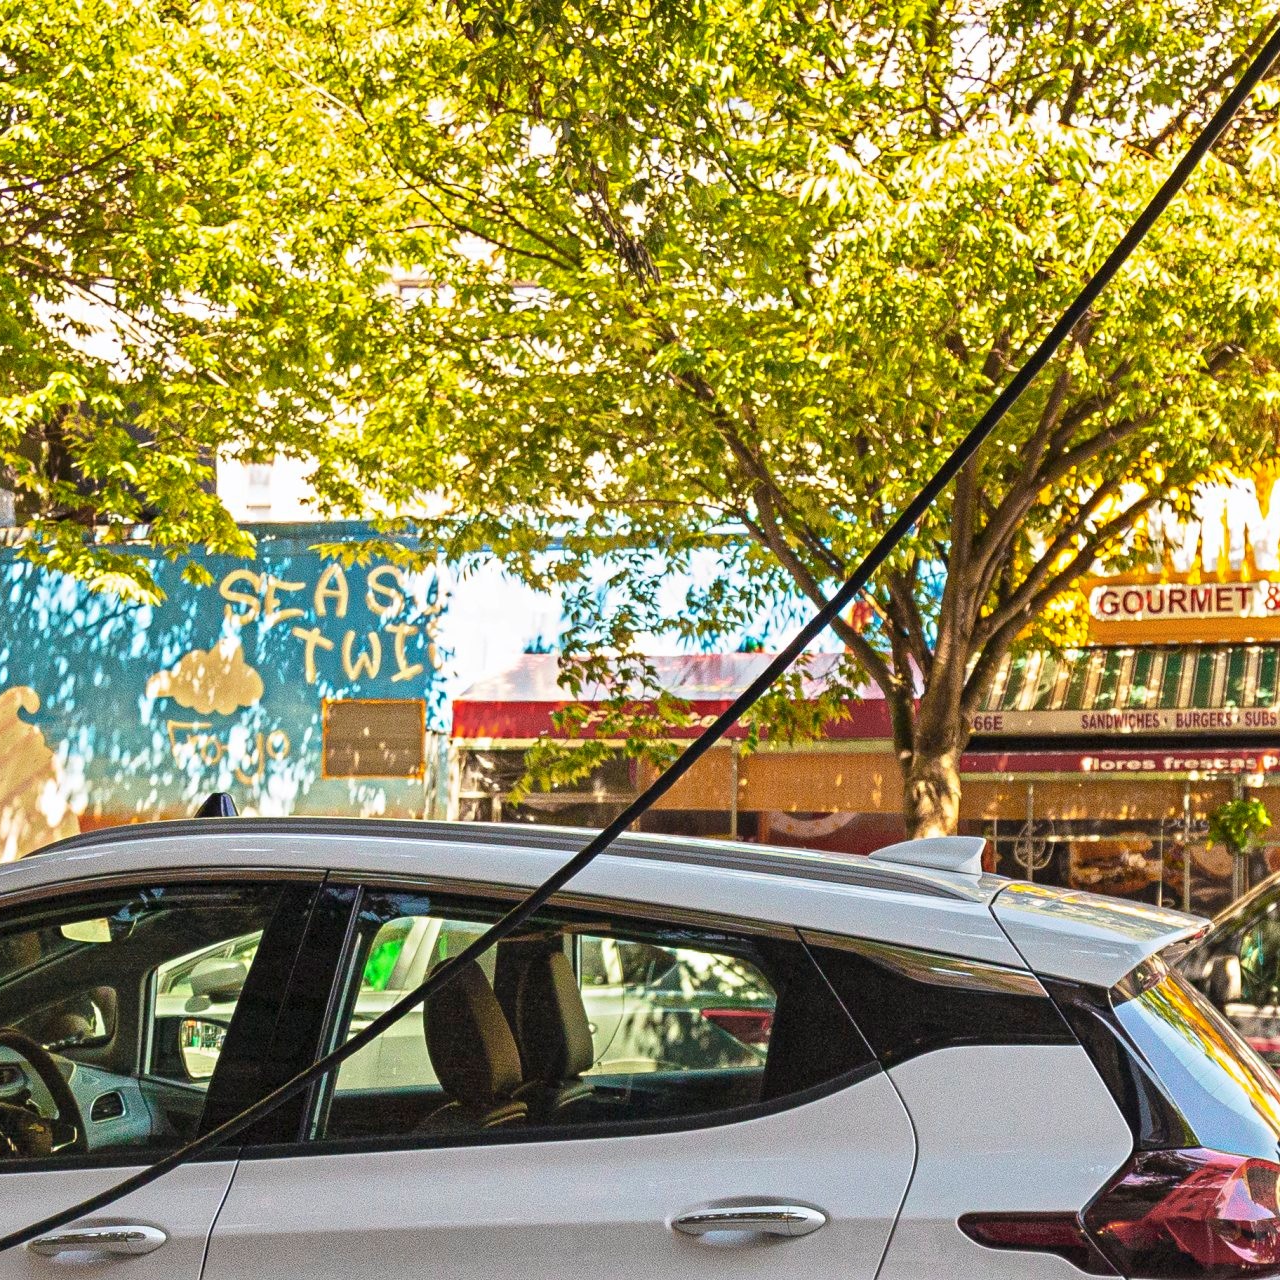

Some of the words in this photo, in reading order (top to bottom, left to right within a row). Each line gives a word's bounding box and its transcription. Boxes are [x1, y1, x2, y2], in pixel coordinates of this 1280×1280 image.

[1099, 587, 1252, 615] GOURMET
[971, 715, 1003, 731] 66E
[1081, 712, 1160, 729] SANDWICHES
[1175, 712, 1232, 729] BURGERS
[1245, 711, 1277, 727] SUBS
[1081, 757, 1156, 771] flores
[1163, 756, 1257, 770] frescas
